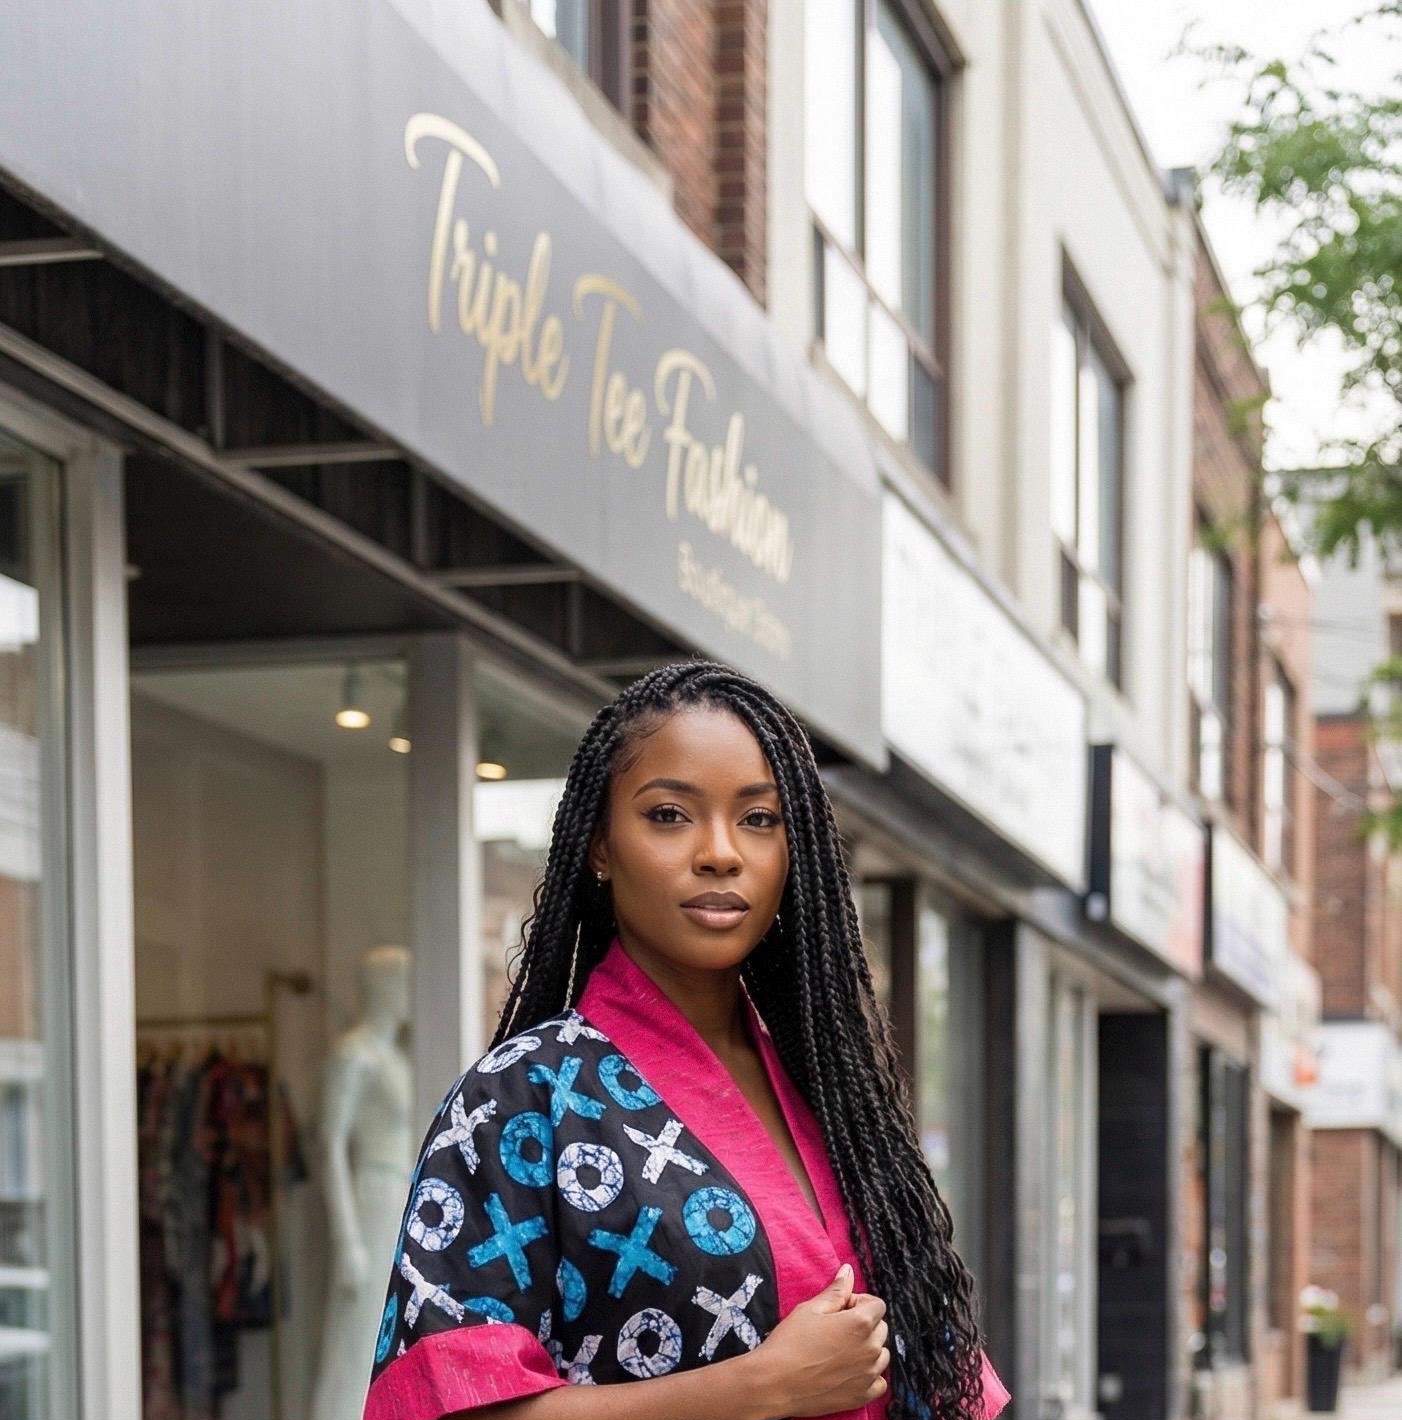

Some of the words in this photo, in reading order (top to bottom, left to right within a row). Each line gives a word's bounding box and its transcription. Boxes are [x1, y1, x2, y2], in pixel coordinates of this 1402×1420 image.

[404, 112, 569, 427] Triple
[573, 273, 650, 469] Tee
[654, 348, 794, 583] Fashion
